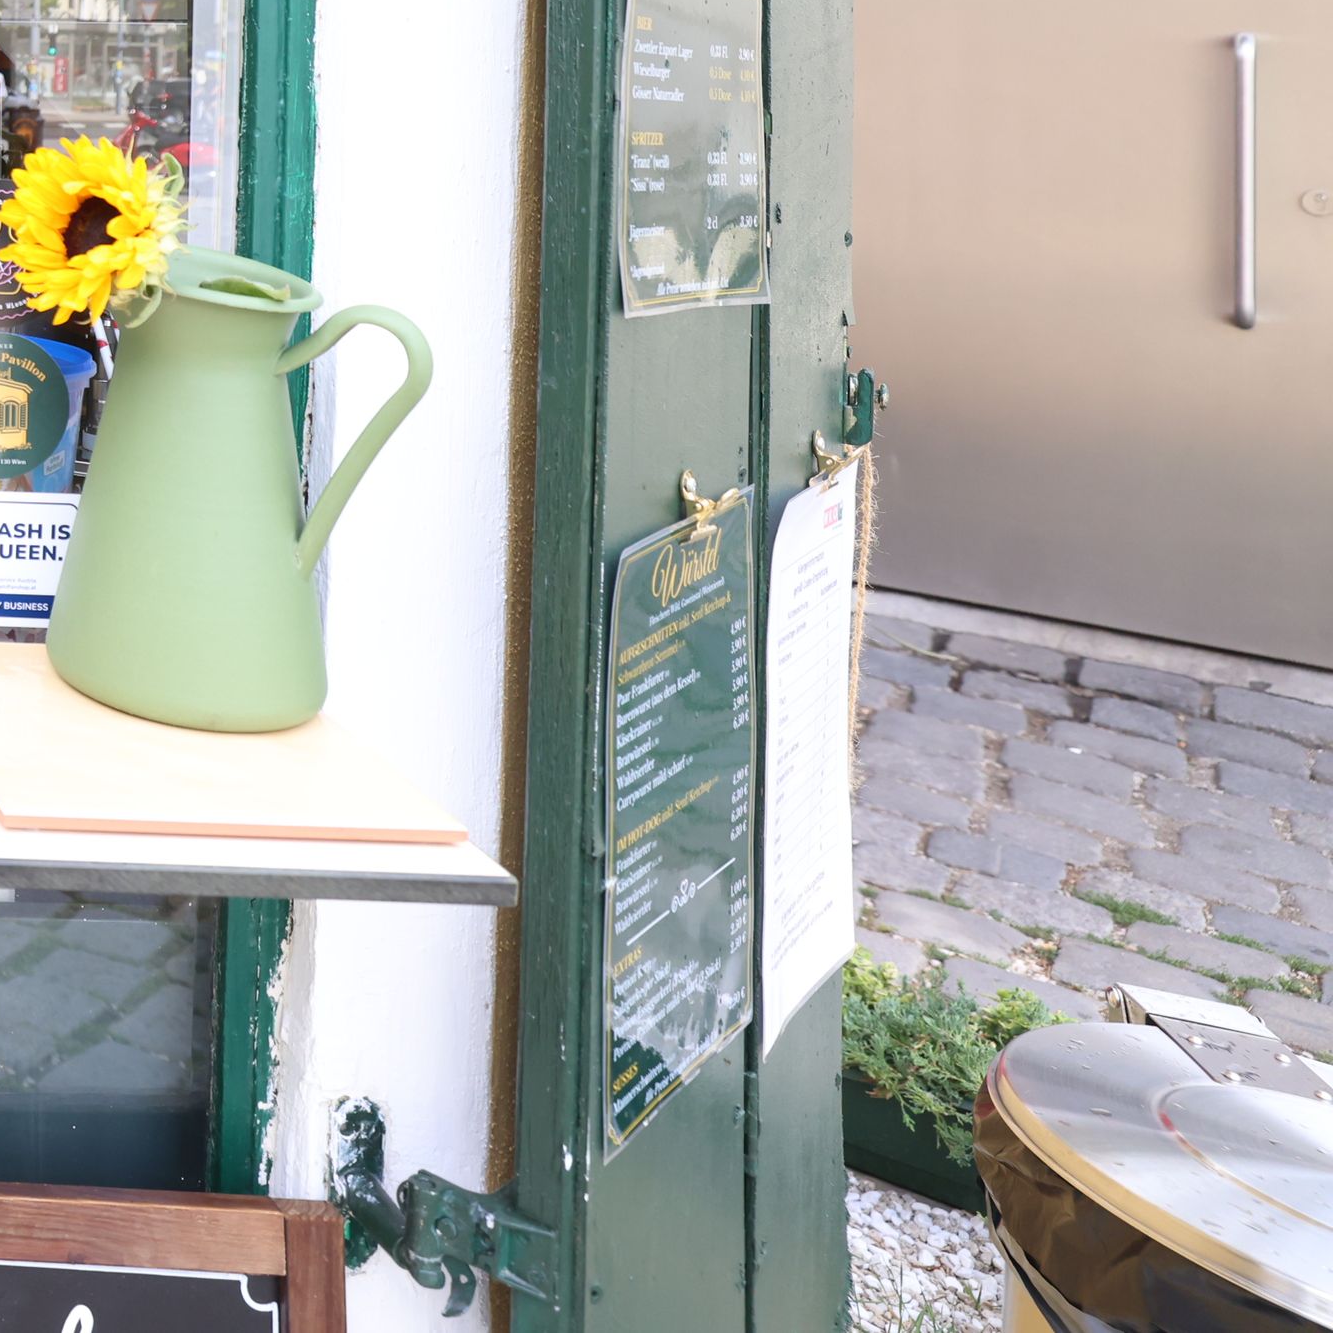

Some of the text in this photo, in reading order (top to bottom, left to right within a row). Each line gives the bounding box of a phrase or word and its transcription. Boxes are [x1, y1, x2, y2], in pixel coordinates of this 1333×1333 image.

[636, 16, 652, 30] BIER
[658, 43, 677, 60] Export
[678, 45, 693, 61] Lager
[631, 131, 663, 146] SPRITZER
[1, 352, 47, 382] Pavillon
[51, 524, 71, 540] IS
[652, 528, 722, 607] Würstel
[3, 601, 48, 611] BUSINESS
[616, 698, 651, 727] Burenwurst
[665, 684, 676, 699] dem
[617, 783, 652, 812] Currywurst
